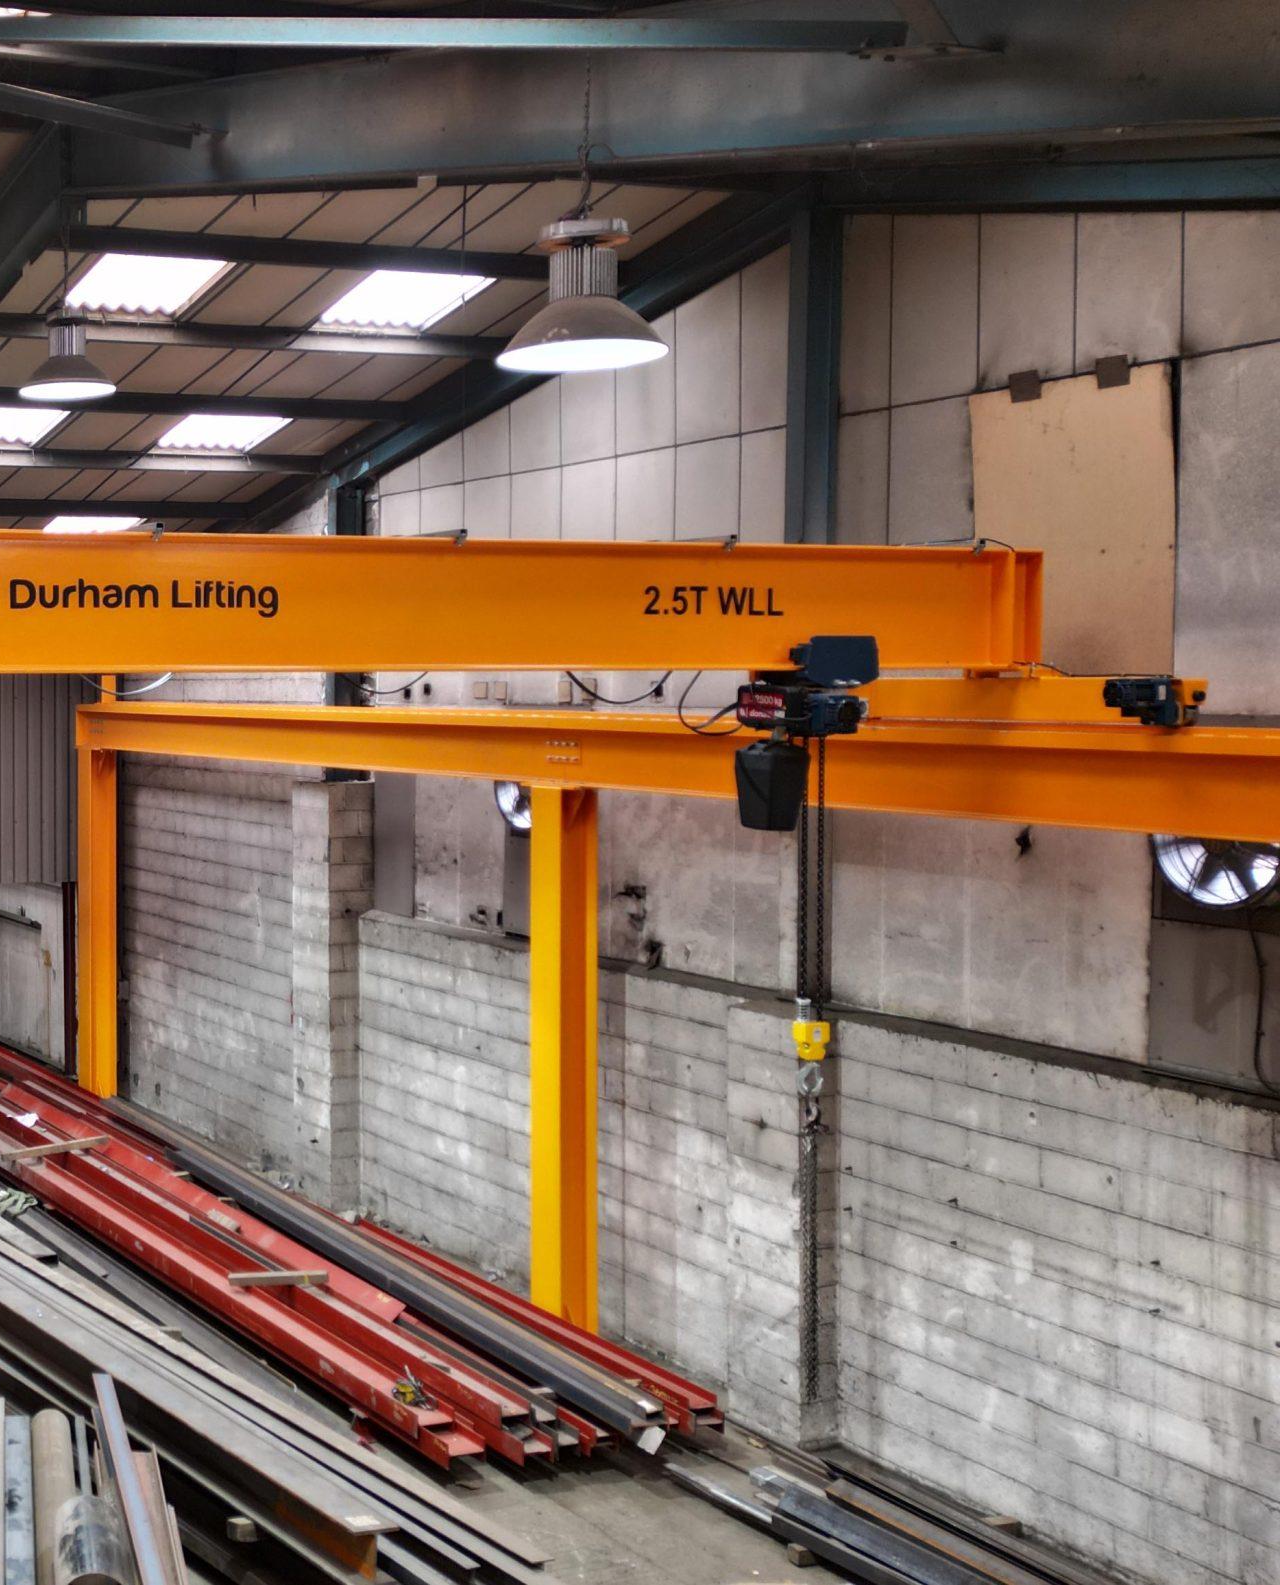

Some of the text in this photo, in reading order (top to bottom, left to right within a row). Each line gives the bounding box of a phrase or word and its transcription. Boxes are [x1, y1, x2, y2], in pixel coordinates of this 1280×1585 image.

[9, 578, 279, 619] Durham Lifting
[643, 585, 784, 617] 2.5T WLL
